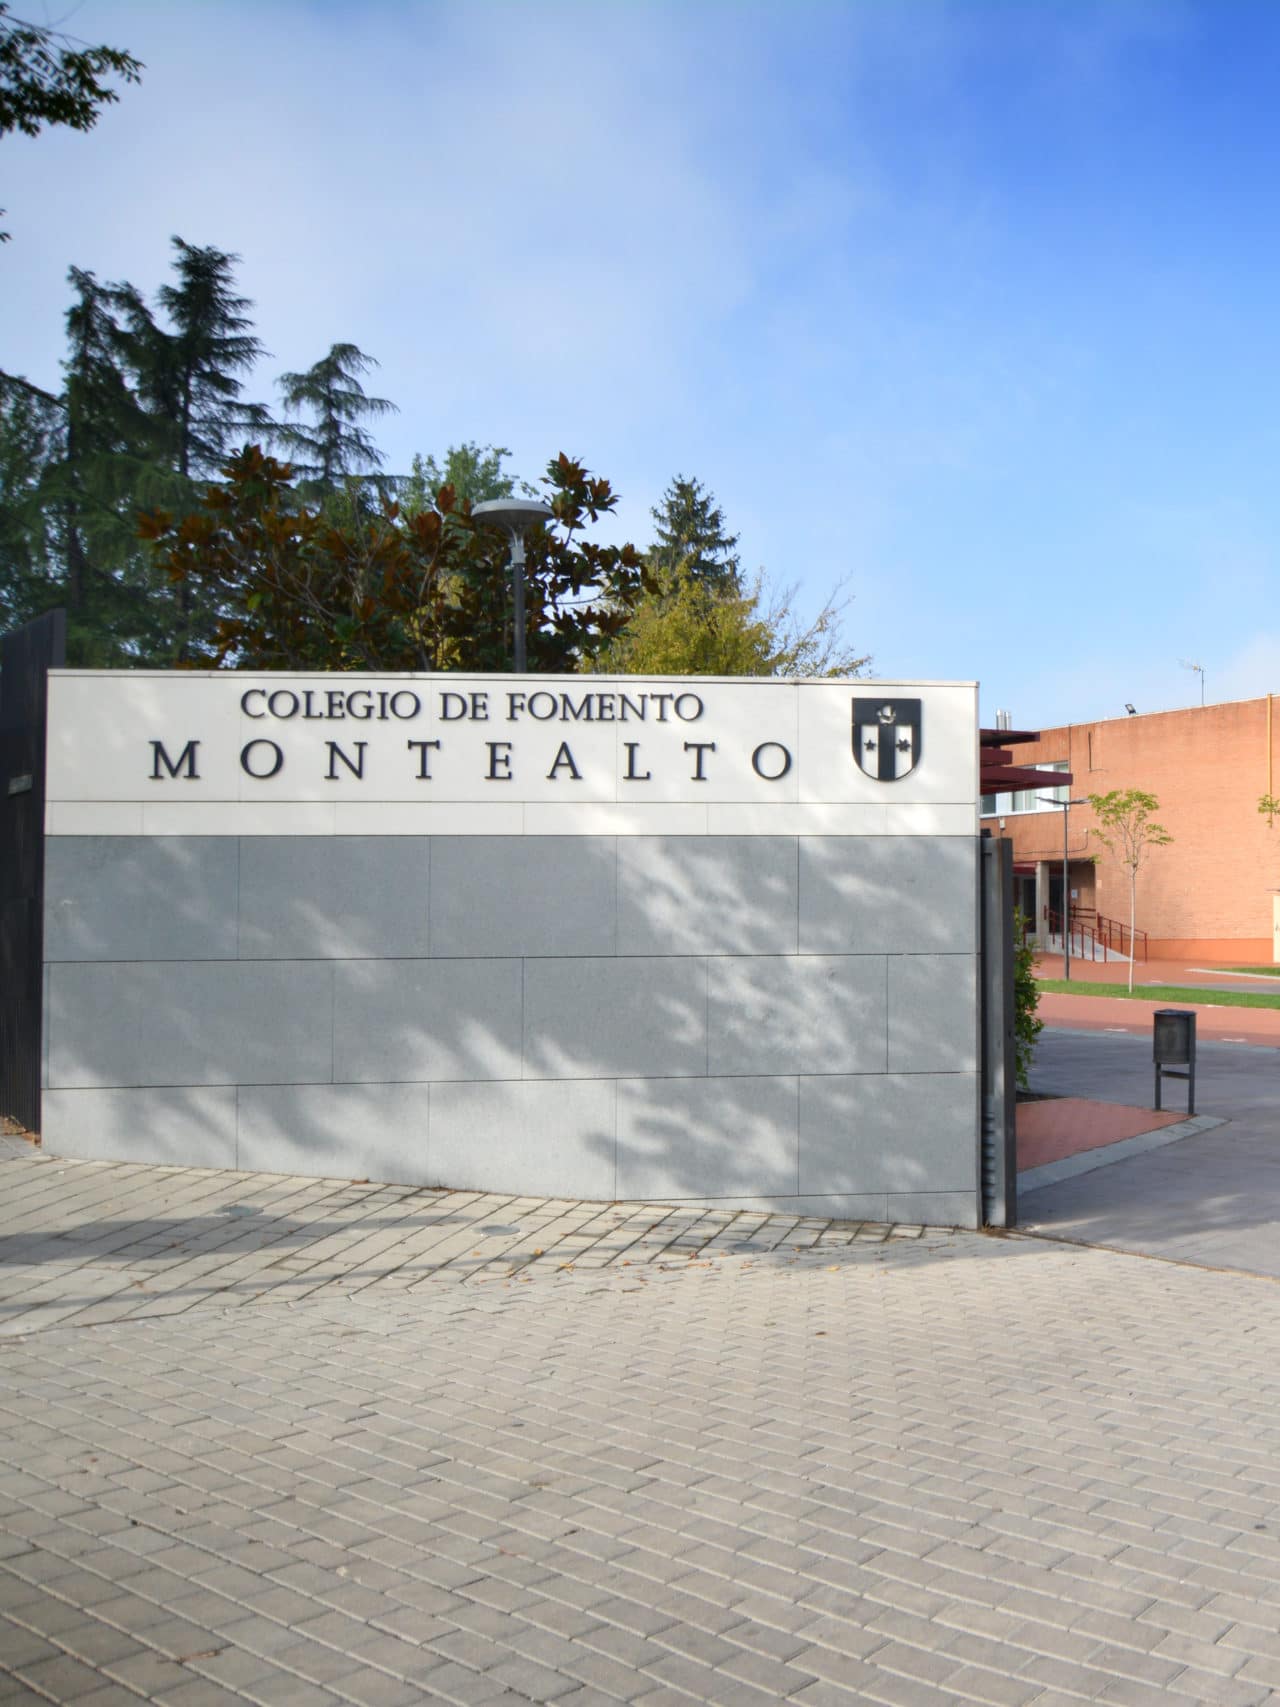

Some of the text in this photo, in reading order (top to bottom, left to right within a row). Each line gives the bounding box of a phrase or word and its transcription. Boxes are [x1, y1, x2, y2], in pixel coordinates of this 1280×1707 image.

[241, 689, 705, 721] COLEGIO DE FOMENTO
[148, 739, 792, 780] MONTEALTO
